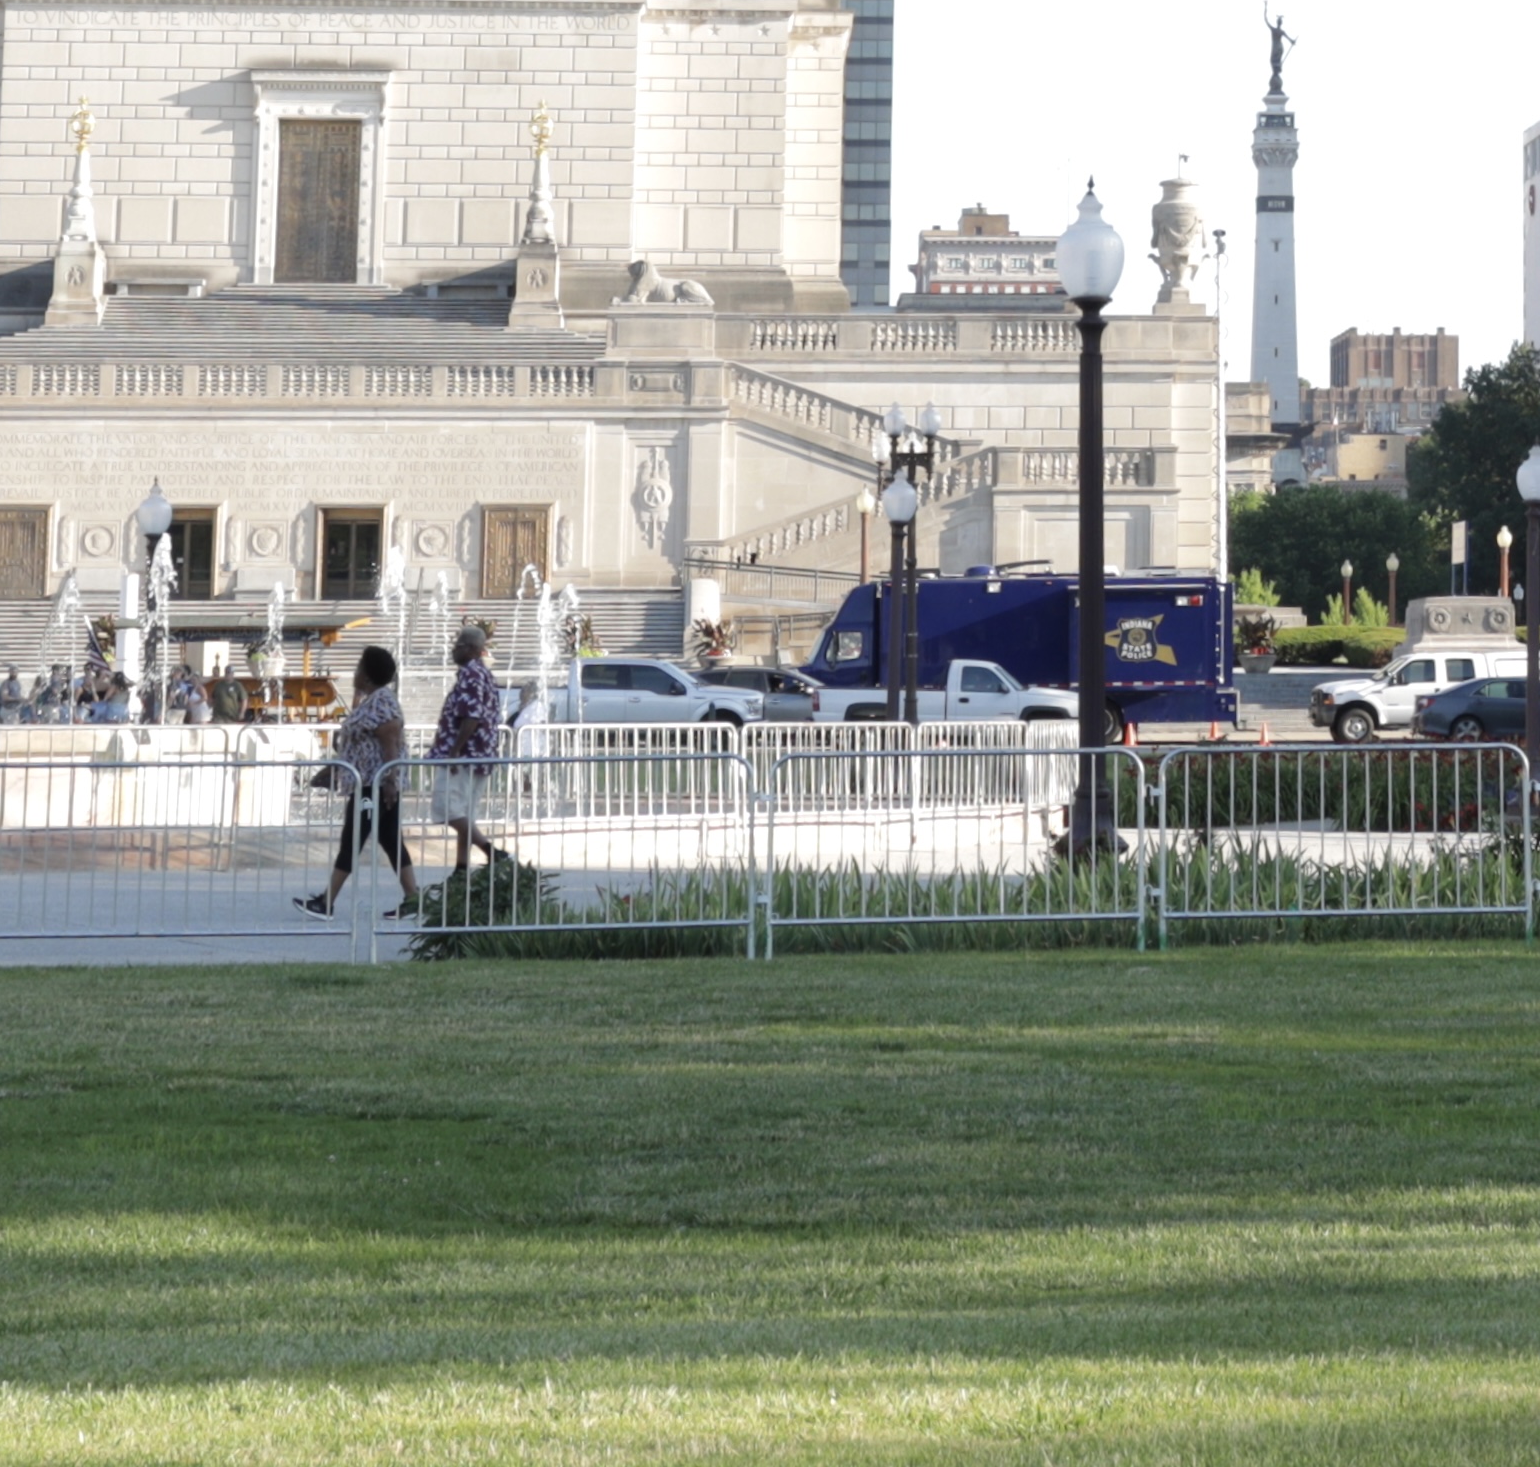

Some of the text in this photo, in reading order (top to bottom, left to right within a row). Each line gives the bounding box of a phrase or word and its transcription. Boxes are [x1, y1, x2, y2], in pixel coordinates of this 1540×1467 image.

[16, 11, 631, 30] TO VINDICATE THE PRINCIPLES OF PEACE AND JUSTICE IN THE WORLD
[88, 434, 113, 445] THE
[115, 434, 157, 445] VALOR
[162, 434, 189, 445] AND
[193, 434, 254, 445] SACRIFICE
[259, 434, 276, 445] OF
[283, 434, 307, 445] THE
[311, 434, 346, 445] LAND
[350, 434, 374, 445] SEA
[378, 434, 405, 445] AND
[406, 434, 427, 445] AIR
[431, 434, 478, 445] FORCES
[505, 434, 530, 445] THE
[5, 447, 35, 458] AND
[36, 447, 61, 458] ALL
[64, 447, 94, 458] WHO
[97, 447, 158, 458] RENDERED
[161, 447, 216, 458] FAITHFUL
[221, 447, 249, 458] AND
[252, 447, 291, 458] LOYAL
[293, 447, 341, 458] SERVICE
[345, 447, 361, 458] AT
[362, 447, 397, 458] HOME
[401, 447, 429, 458] AND
[495, 447, 508, 458] IN
[511, 447, 533, 458] THE
[536, 447, 579, 458] WORLD
[15, 461, 85, 472] INCULCATE
[89, 461, 100, 472] A
[103, 461, 135, 472] TRUE
[139, 461, 247, 472] UNDERSTANDING
[250, 461, 279, 472] AND
[281, 461, 371, 472] APPRECIATION
[374, 461, 393, 472] OF
[397, 461, 421, 472] THE
[423, 461, 492, 472] PRIVILEGES
[495, 461, 512, 472] OF
[515, 461, 579, 472] AMERICAN
[52, 474, 70, 485] TO
[75, 474, 124, 485] INSPIRE
[215, 474, 246, 485] AND
[252, 474, 308, 485] RESPECT
[315, 474, 341, 485] FOR
[347, 474, 372, 485] THE
[377, 474, 404, 485] LAW
[410, 474, 429, 485] TO
[433, 474, 458, 485] THE
[464, 474, 493, 485] END
[498, 474, 530, 485] THAT
[52, 488, 101, 499] JUSTICE
[106, 488, 120, 499] BE
[228, 488, 271, 499] PUBLIC
[275, 488, 318, 499] ORDER
[322, 488, 403, 499] MAINTAINED
[408, 488, 435, 499] AND
[438, 488, 487, 499] LIBERTY
[70, 501, 135, 512] MCMXIV
[1121, 620, 1153, 631] INDIANA
[1122, 642, 1153, 653] STATE
[1121, 650, 1153, 660] POLICE
